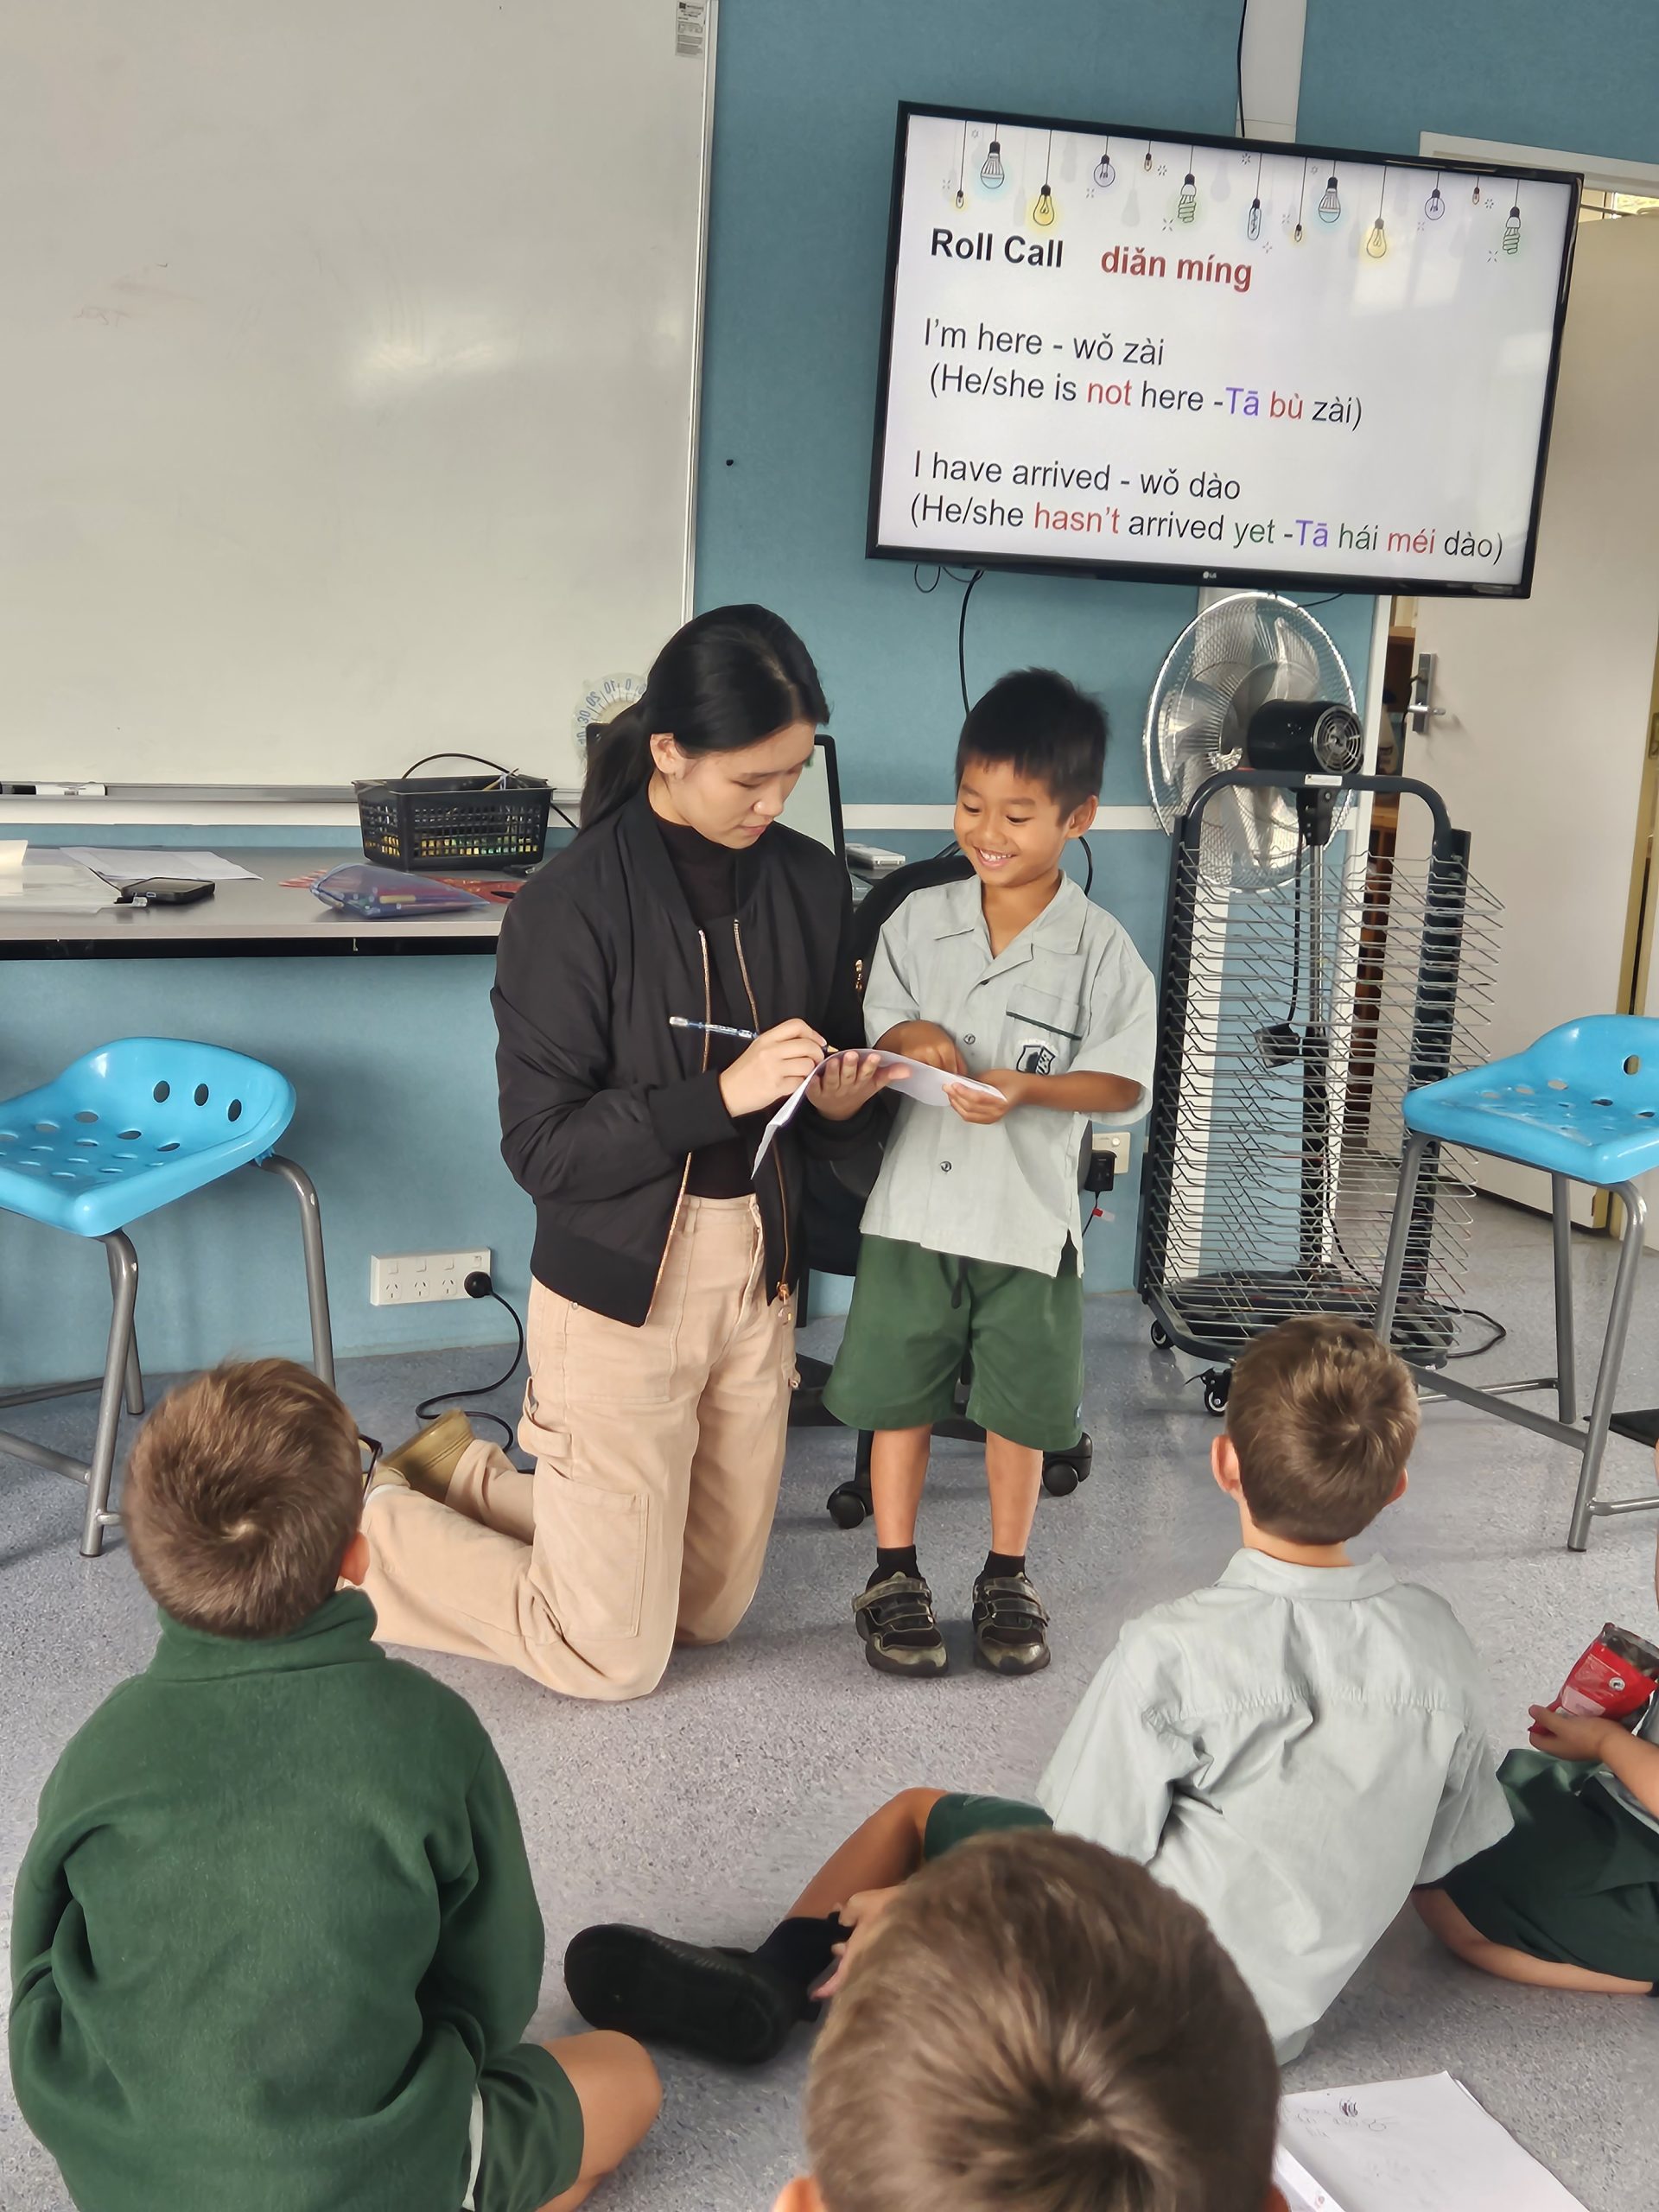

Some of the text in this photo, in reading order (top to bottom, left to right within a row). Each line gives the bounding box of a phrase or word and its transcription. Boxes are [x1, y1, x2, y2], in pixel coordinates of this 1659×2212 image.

[931, 227, 1064, 269] Roll Call
[1101, 245, 1252, 293] diǎn míng
[977, 321, 1043, 355] here
[1073, 332, 1114, 361] wǒ
[1122, 337, 1165, 366] zài
[930, 362, 1045, 399] (He/she
[1054, 372, 1077, 402] is
[1087, 379, 1133, 407] not
[1141, 379, 1204, 412] here
[1269, 390, 1304, 420] bù
[1311, 396, 1362, 432] zài)
[914, 449, 921, 478] I
[932, 451, 1002, 483] have
[1012, 460, 1111, 492] arrived
[1140, 467, 1179, 496] wǒ
[1189, 471, 1241, 500] dào
[911, 492, 1024, 529] (He/she
[1128, 511, 1224, 541] arrived
[1233, 518, 1275, 550] yet
[1338, 522, 1379, 551] hái
[1387, 528, 1436, 555] méi
[1444, 530, 1503, 566] dào)
